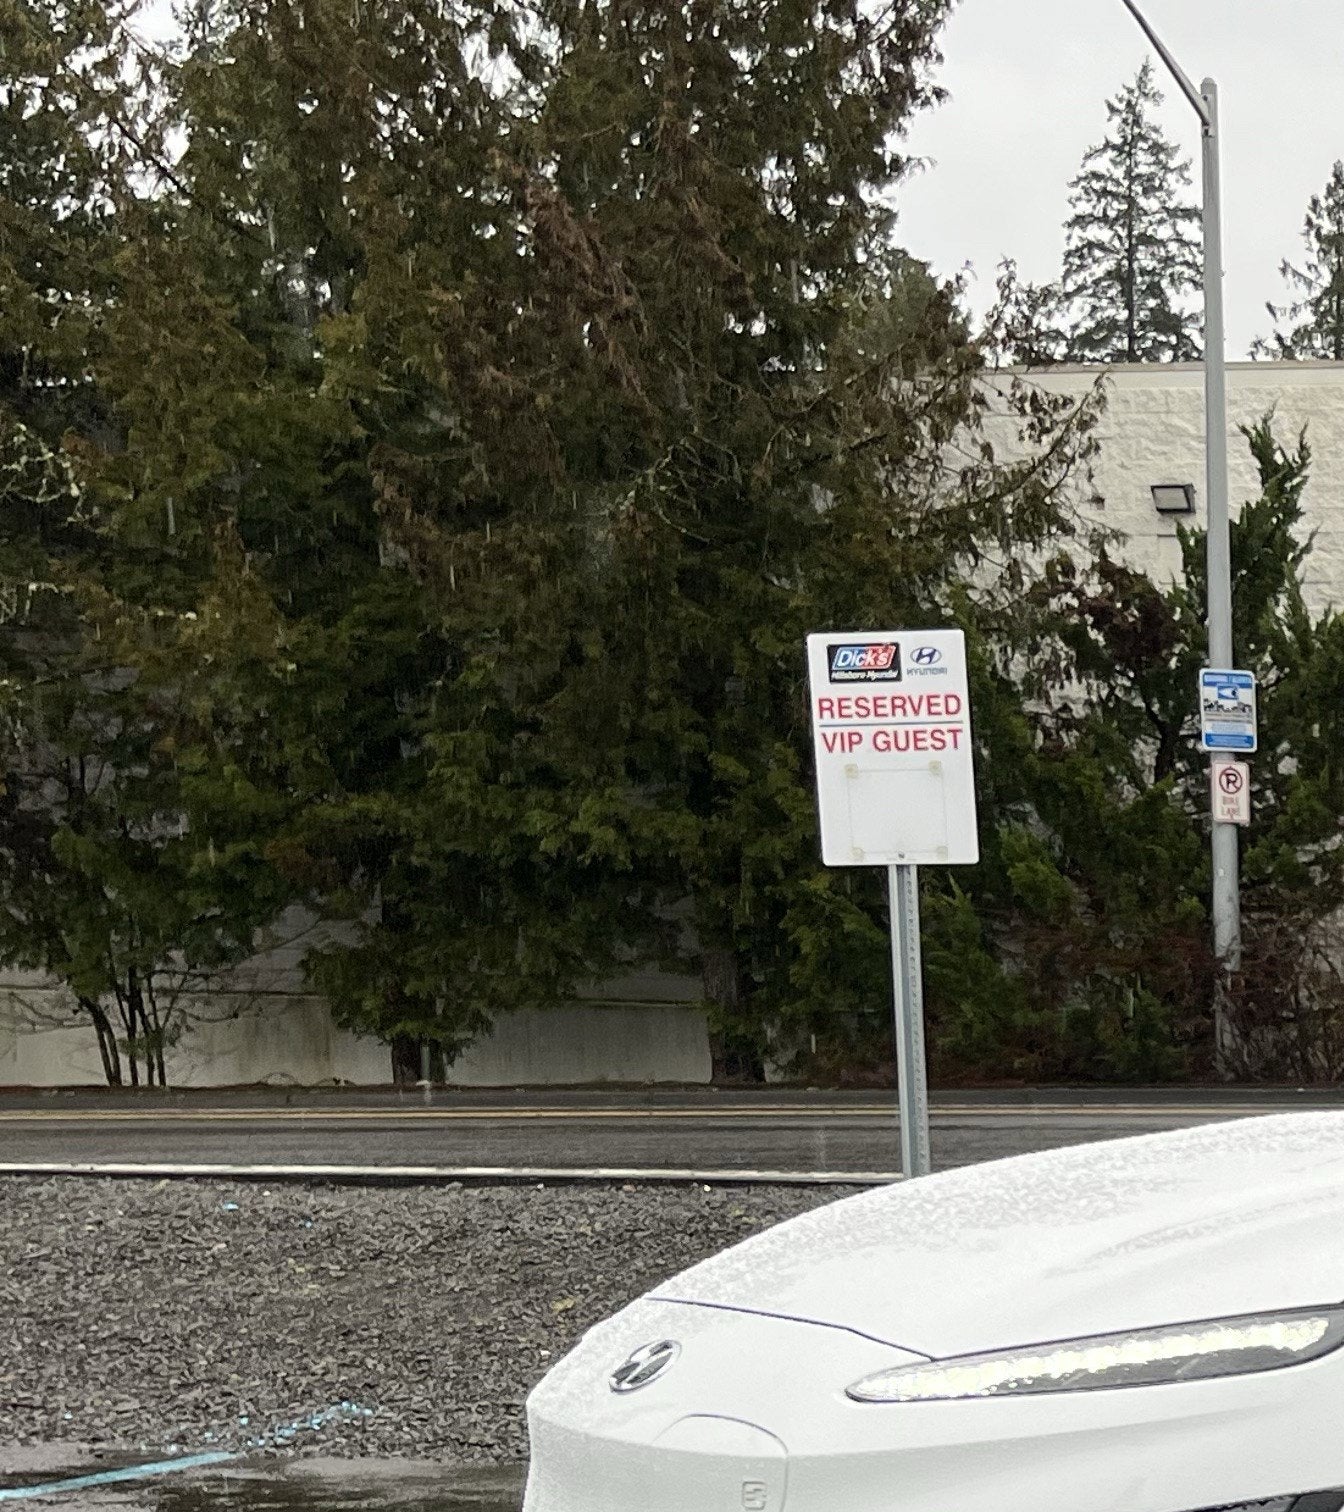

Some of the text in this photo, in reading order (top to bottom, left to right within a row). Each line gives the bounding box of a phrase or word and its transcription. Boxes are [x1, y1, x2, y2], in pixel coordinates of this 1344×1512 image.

[837, 649, 889, 668] Dick's
[906, 666, 948, 676] HYUNDAI
[818, 694, 962, 720] RESERVED
[821, 728, 963, 753] VIP GUEST
